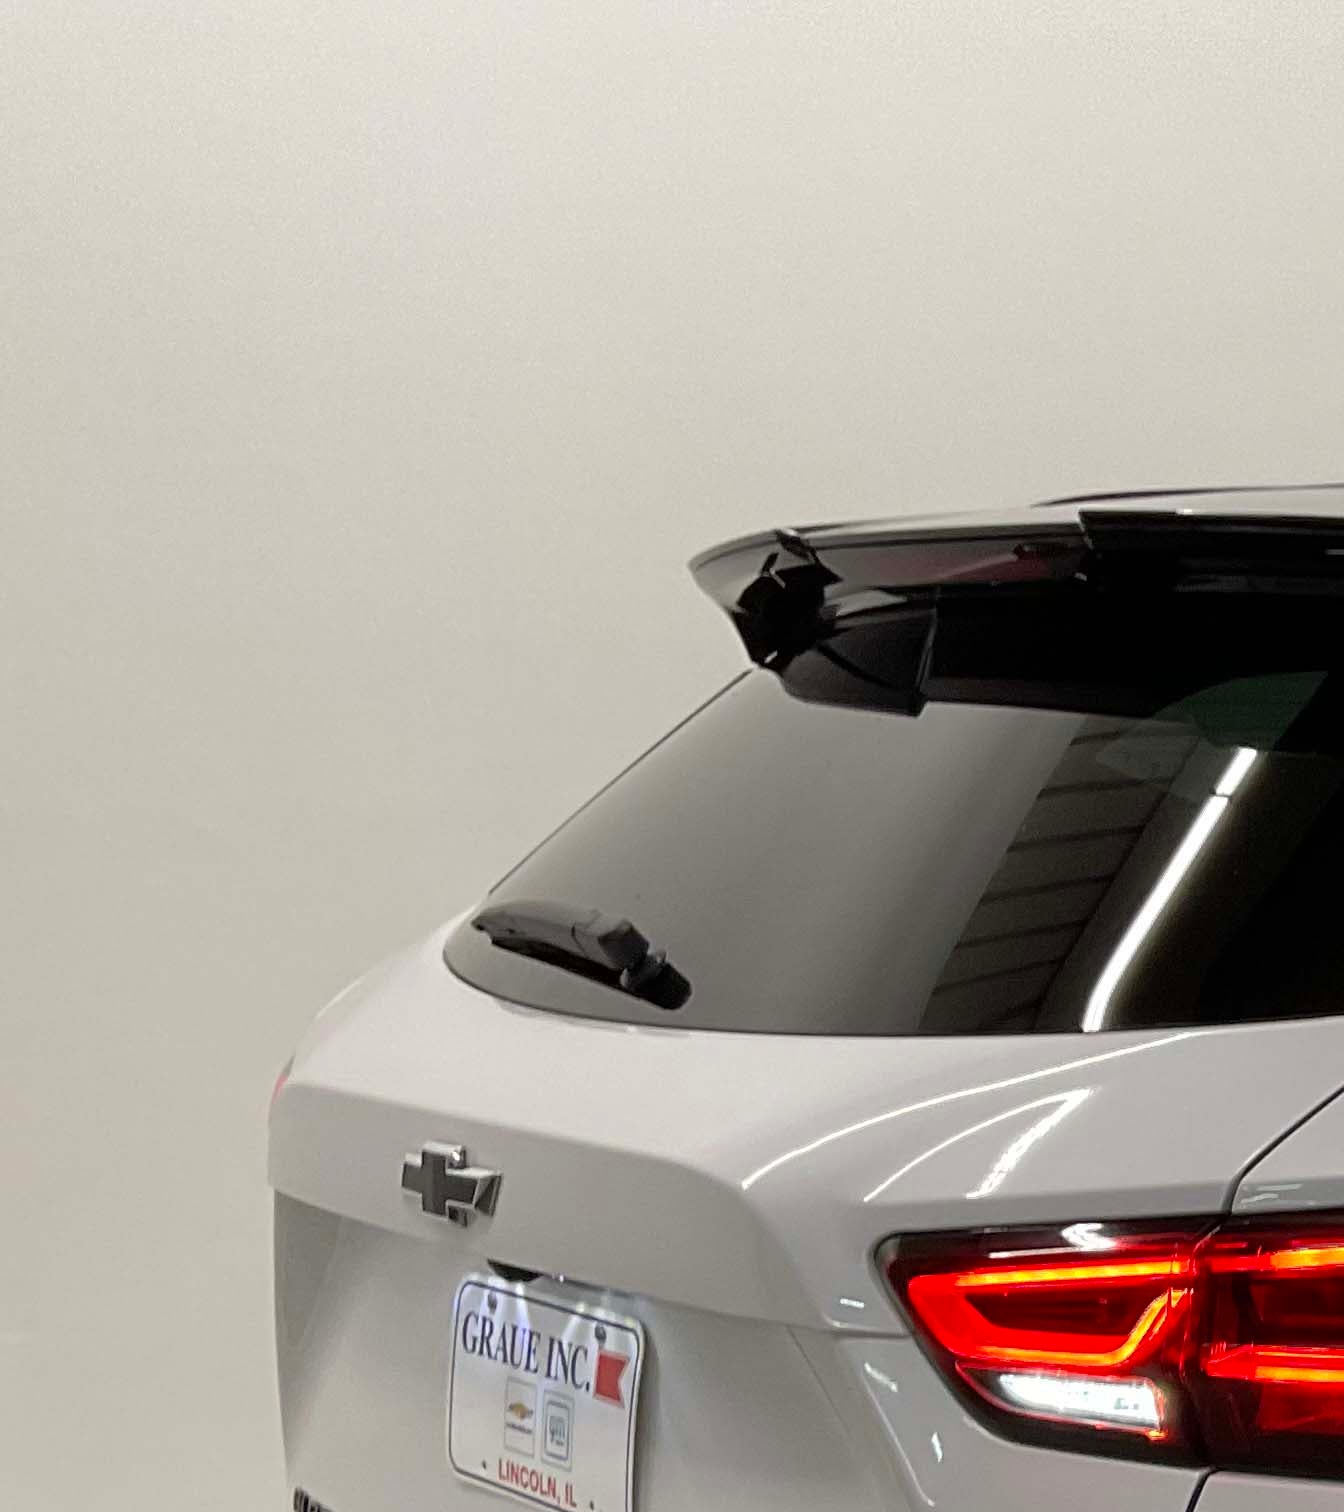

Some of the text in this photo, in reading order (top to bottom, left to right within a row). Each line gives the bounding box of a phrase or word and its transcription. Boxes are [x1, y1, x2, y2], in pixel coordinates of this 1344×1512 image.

[462, 1311, 590, 1392] GRAUE INC.
[498, 1457, 577, 1508] LINCOLN, IL
